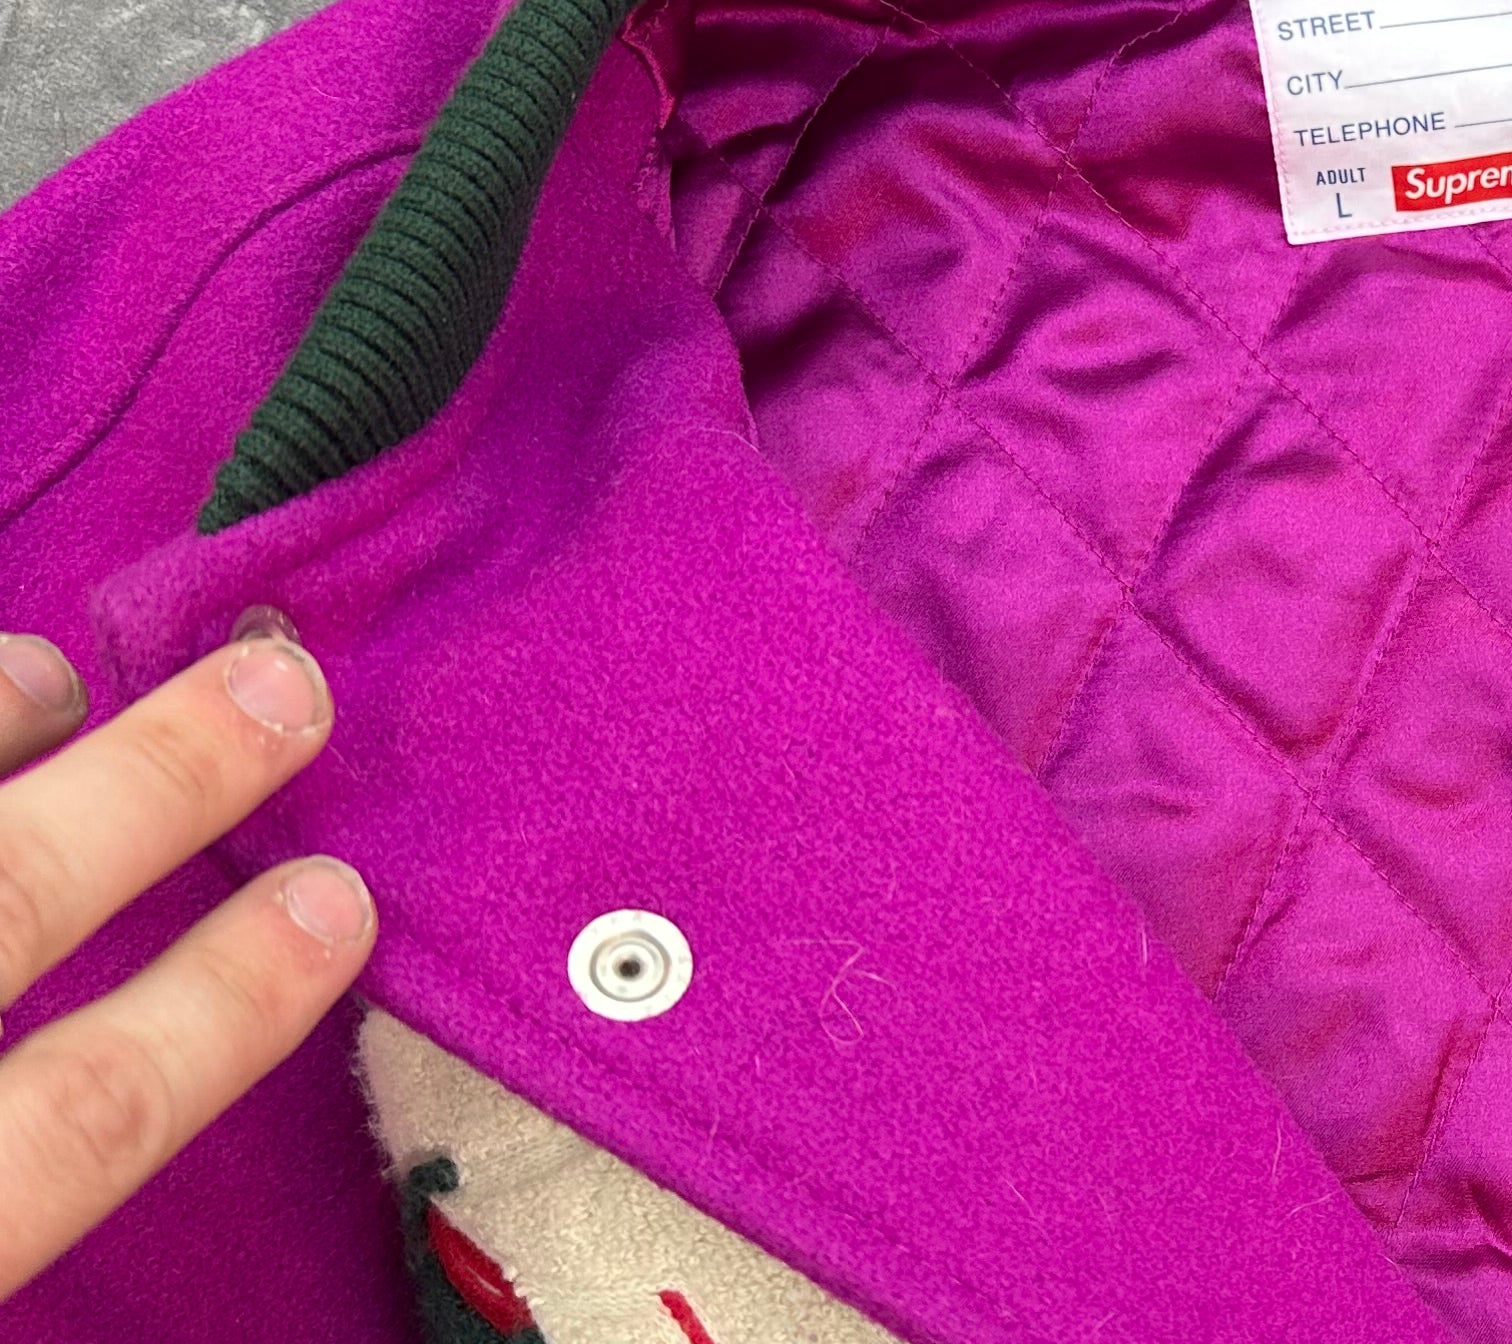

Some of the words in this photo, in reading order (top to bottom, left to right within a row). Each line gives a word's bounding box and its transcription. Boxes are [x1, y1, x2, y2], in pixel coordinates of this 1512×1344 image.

[1277, 10, 1376, 41] STREET
[1287, 70, 1344, 95] CITY
[1294, 112, 1446, 147] TELEPHONE
[1316, 167, 1366, 186] ADULT
[1336, 193, 1352, 218] L
